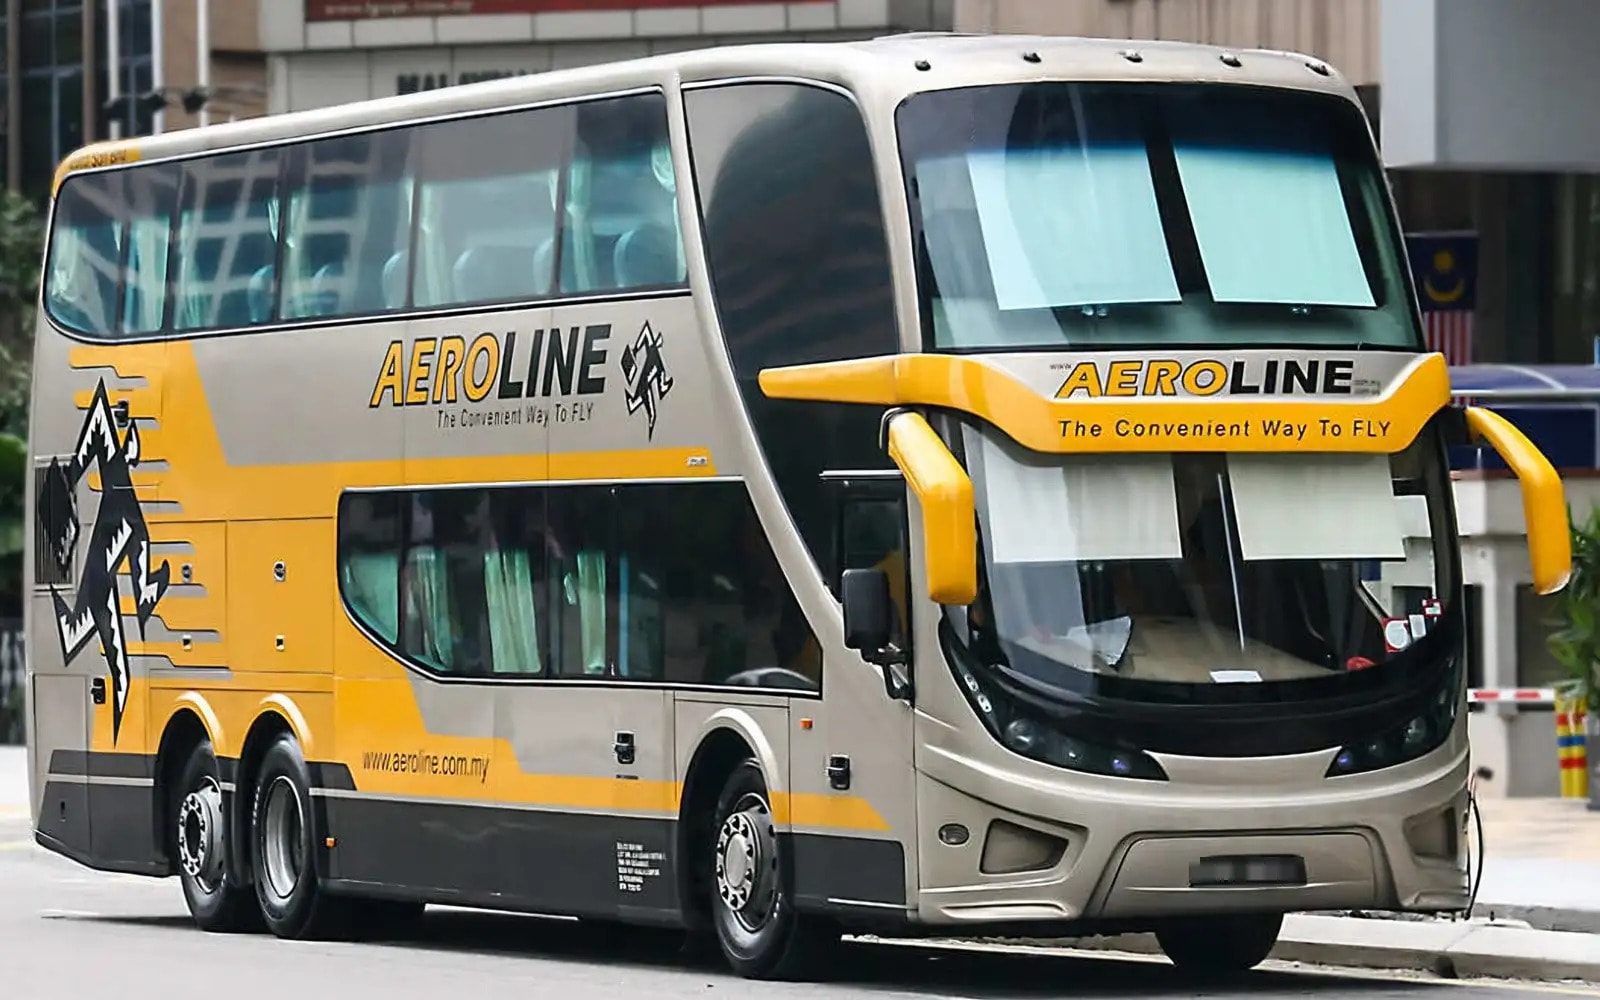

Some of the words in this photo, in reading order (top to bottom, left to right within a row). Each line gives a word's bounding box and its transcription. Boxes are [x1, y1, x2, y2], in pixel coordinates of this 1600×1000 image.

[369, 323, 612, 409] AEROLINE
[1054, 359, 1355, 398] AEROLINE
[438, 409, 456, 428] The
[460, 403, 522, 427] Convenient
[526, 405, 549, 428] Way
[555, 403, 567, 422] To
[571, 402, 594, 422] FLY
[1059, 420, 1102, 437] The
[1115, 419, 1250, 437] Convenient
[1262, 420, 1308, 441] Way
[1319, 420, 1342, 437] To
[1352, 420, 1392, 438] FLY
[362, 750, 490, 784] www.aeroline.com.my
